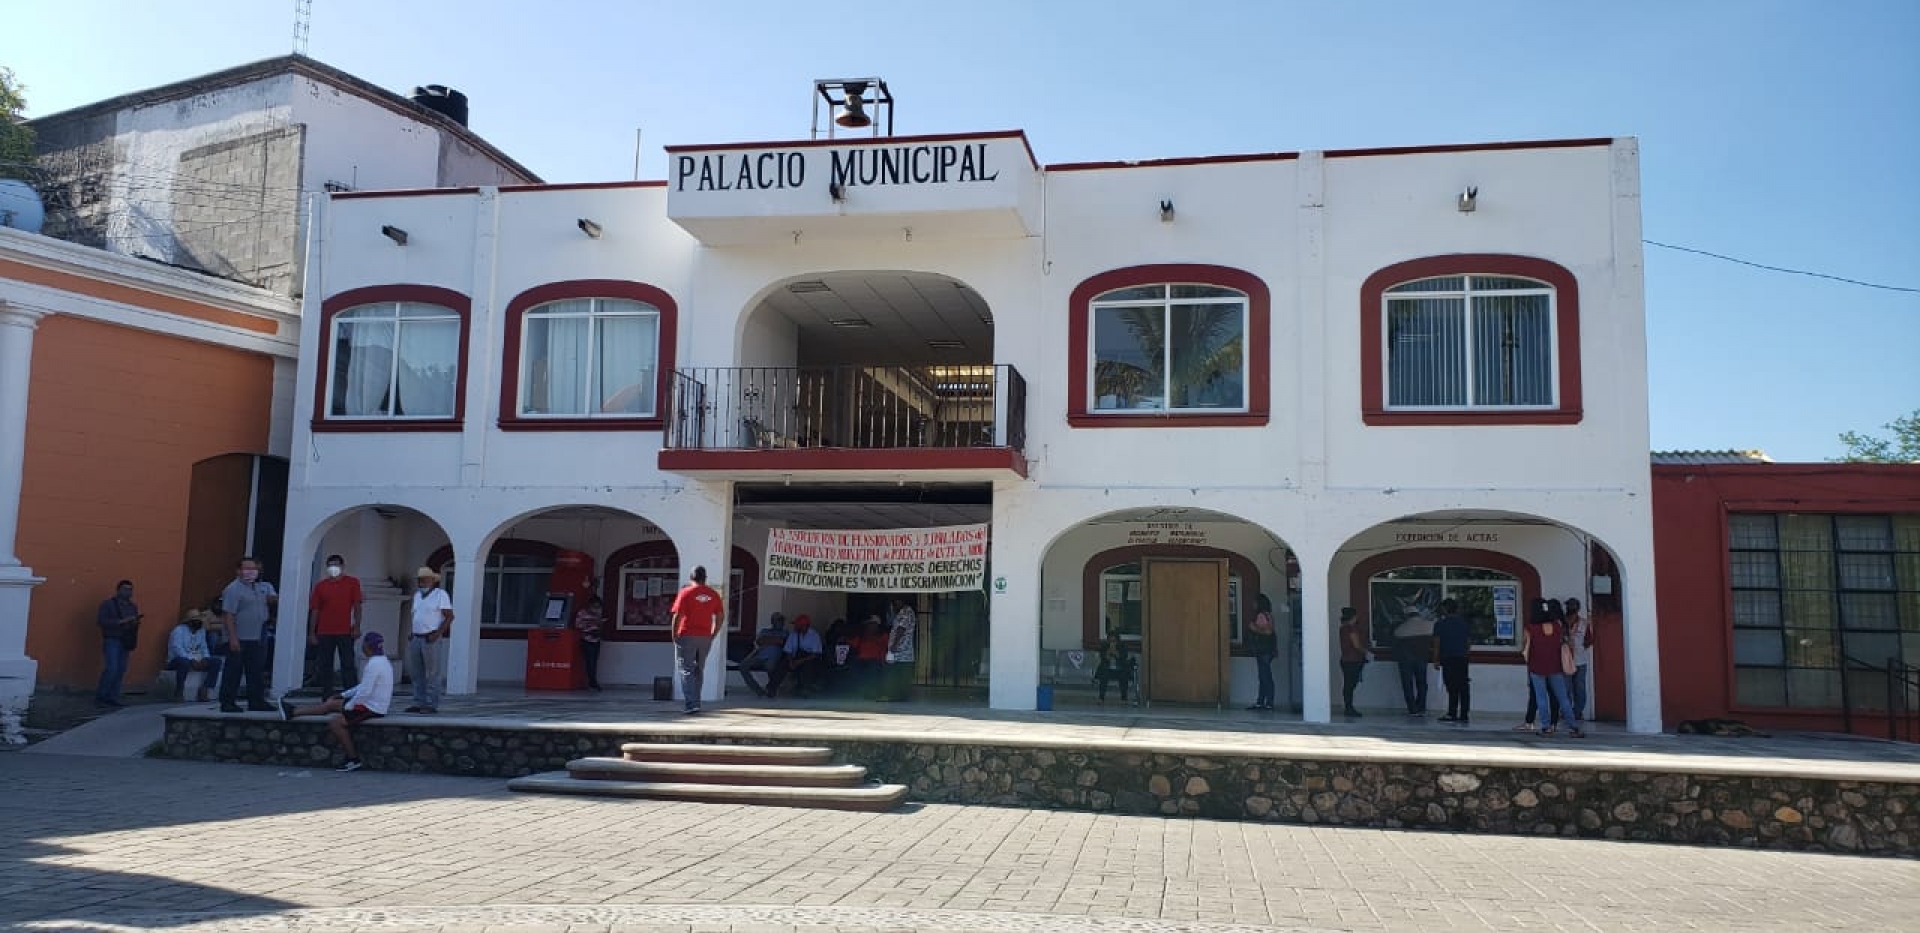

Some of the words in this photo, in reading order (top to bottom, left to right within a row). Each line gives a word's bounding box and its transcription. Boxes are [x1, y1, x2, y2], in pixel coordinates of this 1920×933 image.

[678, 152, 805, 192] PALACIO
[829, 144, 998, 187] MUNICIPAL
[1466, 533, 1498, 541] ACTAS
[817, 561, 859, 576] RESPETO
[861, 564, 868, 576] A
[869, 562, 925, 575] NUESTROS
[929, 558, 982, 574] DERECHOS
[768, 568, 859, 589] CONSTITUCIONALES
[888, 576, 898, 588] LA
